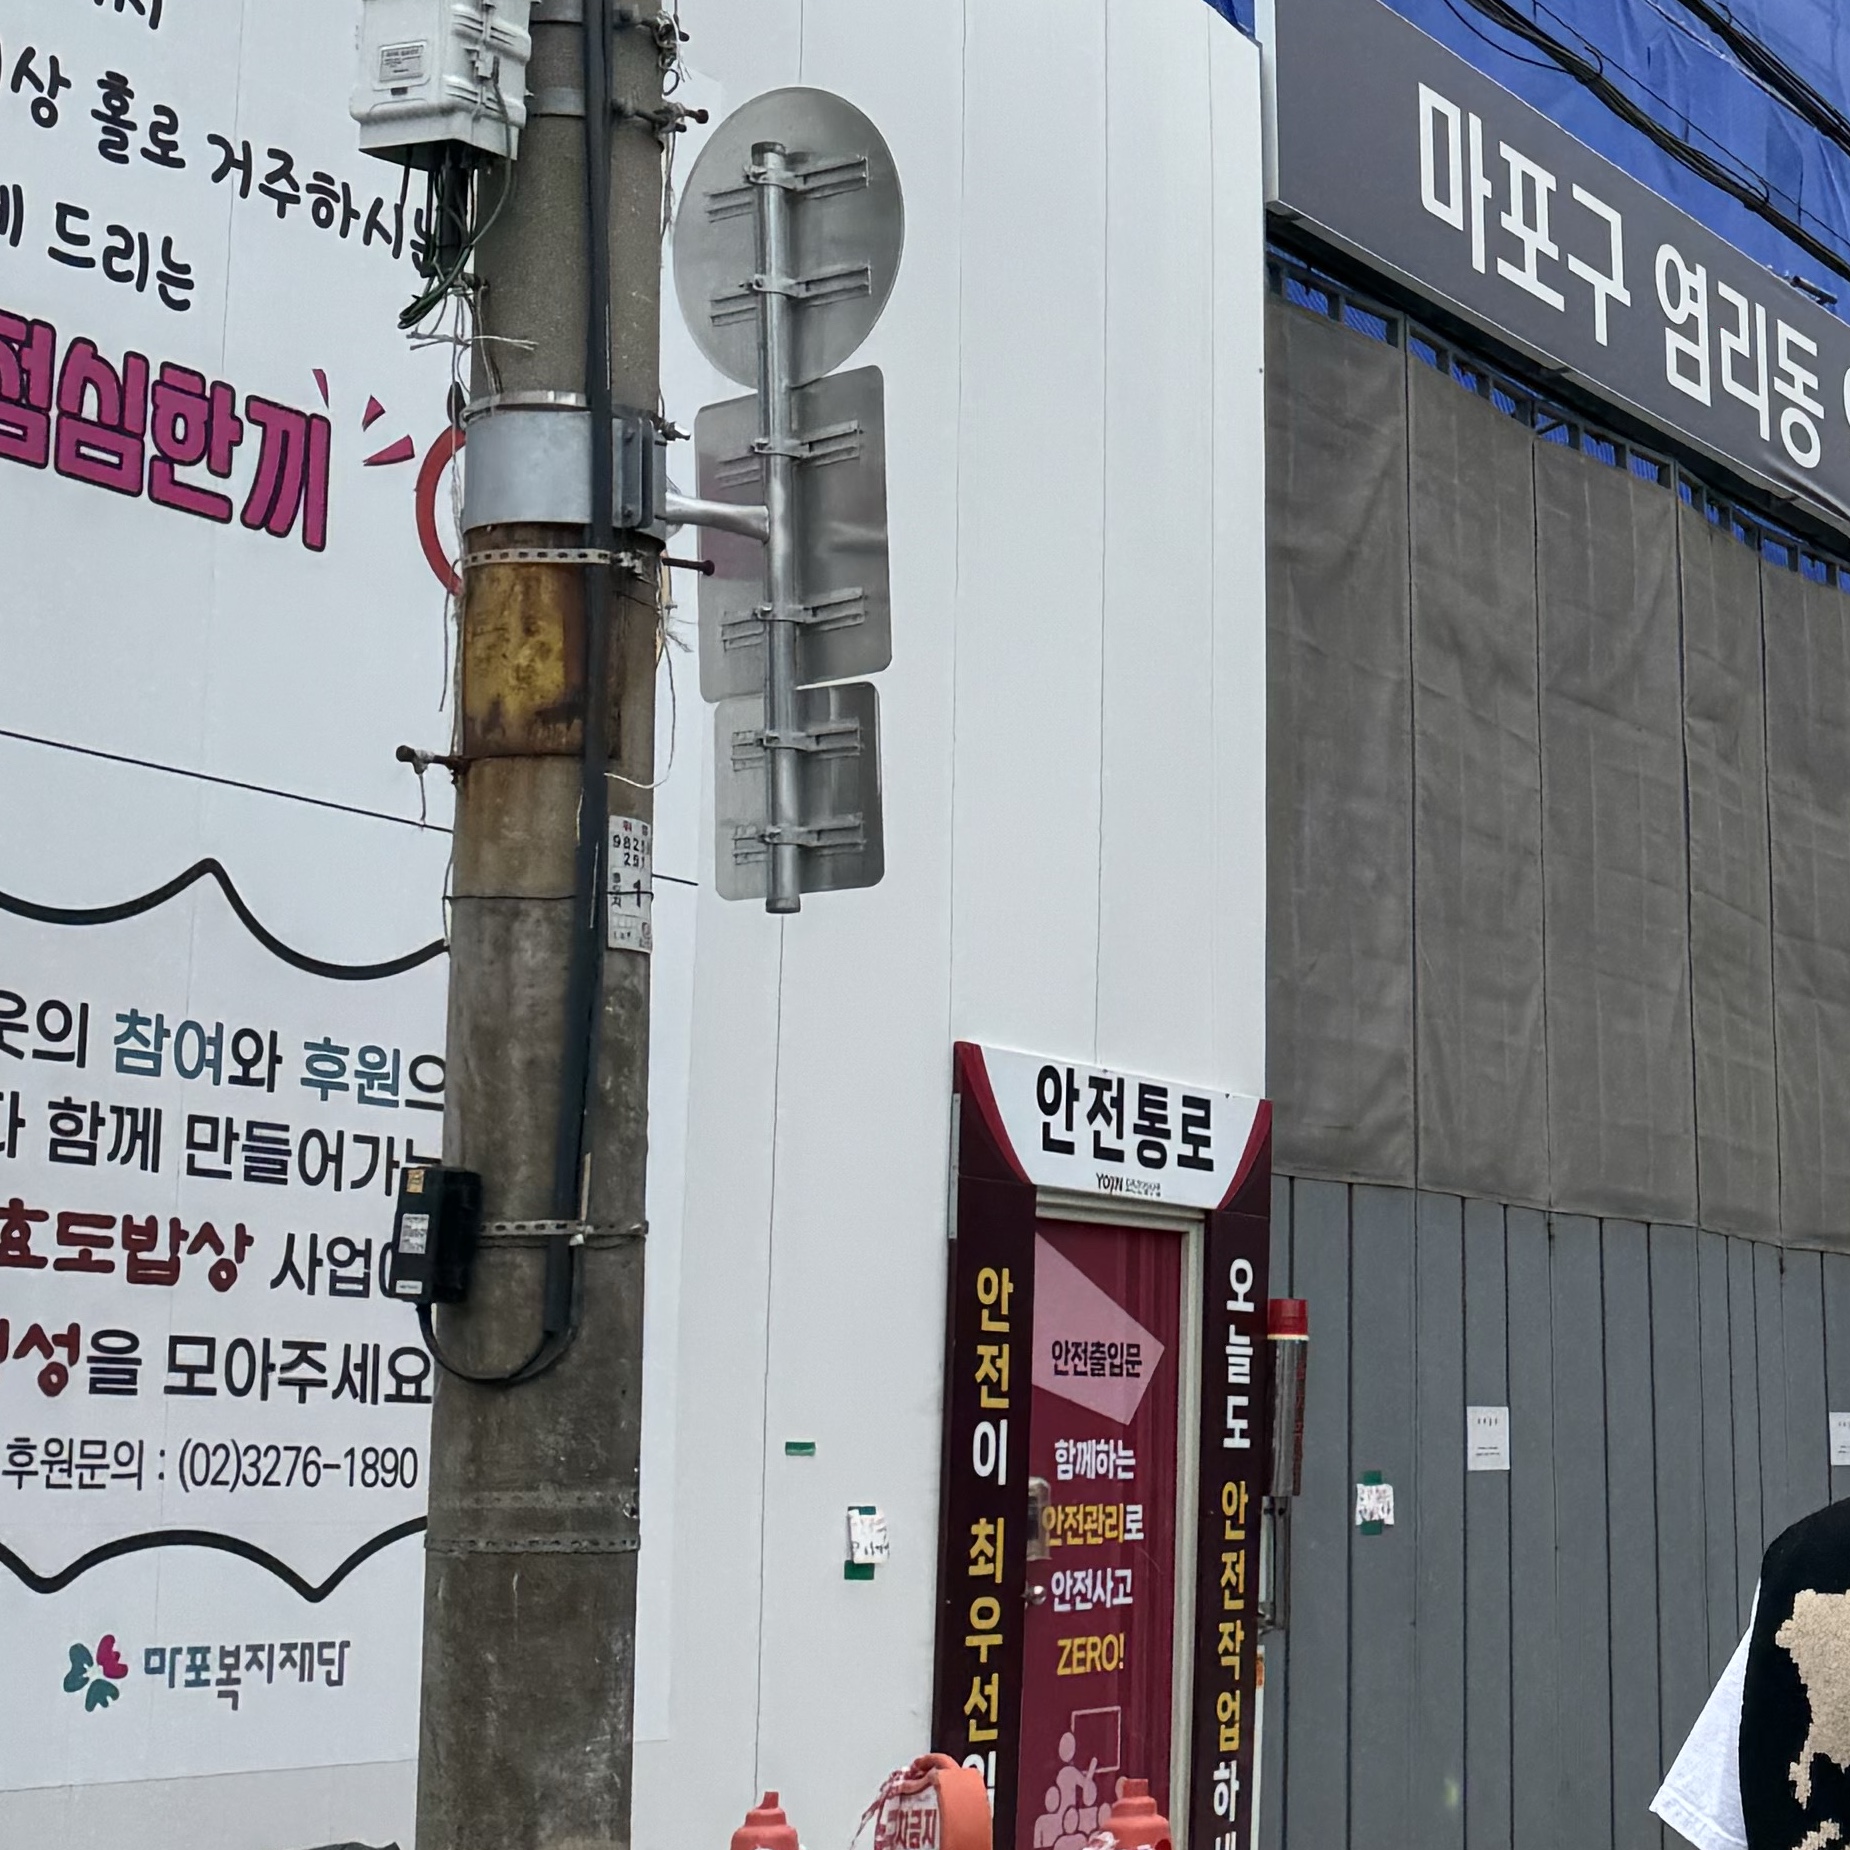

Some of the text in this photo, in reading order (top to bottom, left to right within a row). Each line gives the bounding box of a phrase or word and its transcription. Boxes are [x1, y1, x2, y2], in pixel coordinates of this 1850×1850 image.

[0, 46, 72, 128] 상
[91, 71, 186, 168] 홀로
[48, 203, 195, 311] 드리는
[1418, 83, 1631, 346] 마포구
[1655, 244, 1825, 468] 염리동
[0, 308, 331, 552] 점심한끼
[114, 1008, 283, 1092] 참여와
[48, 1096, 162, 1173] 함께
[1036, 1064, 1215, 1172] 안전통로
[0, 1198, 254, 1292] 효도밥상
[0, 1318, 433, 1405] 성을 모아주세요
[972, 1267, 1014, 1486] 안전이
[1051, 1340, 1143, 1378] 안전출입문
[1222, 1257, 1256, 1450] 오늘도
[2, 1437, 145, 1491] 후원문의
[178, 1437, 419, 1492] (02)3276-1890
[1055, 1439, 1136, 1481] 함께하는
[1041, 1504, 1144, 1547] 안전관리로
[1050, 1568, 1134, 1613] 안전사고
[144, 1641, 351, 1711] 마포복지재단
[1056, 1633, 1125, 1676] ZERO!
